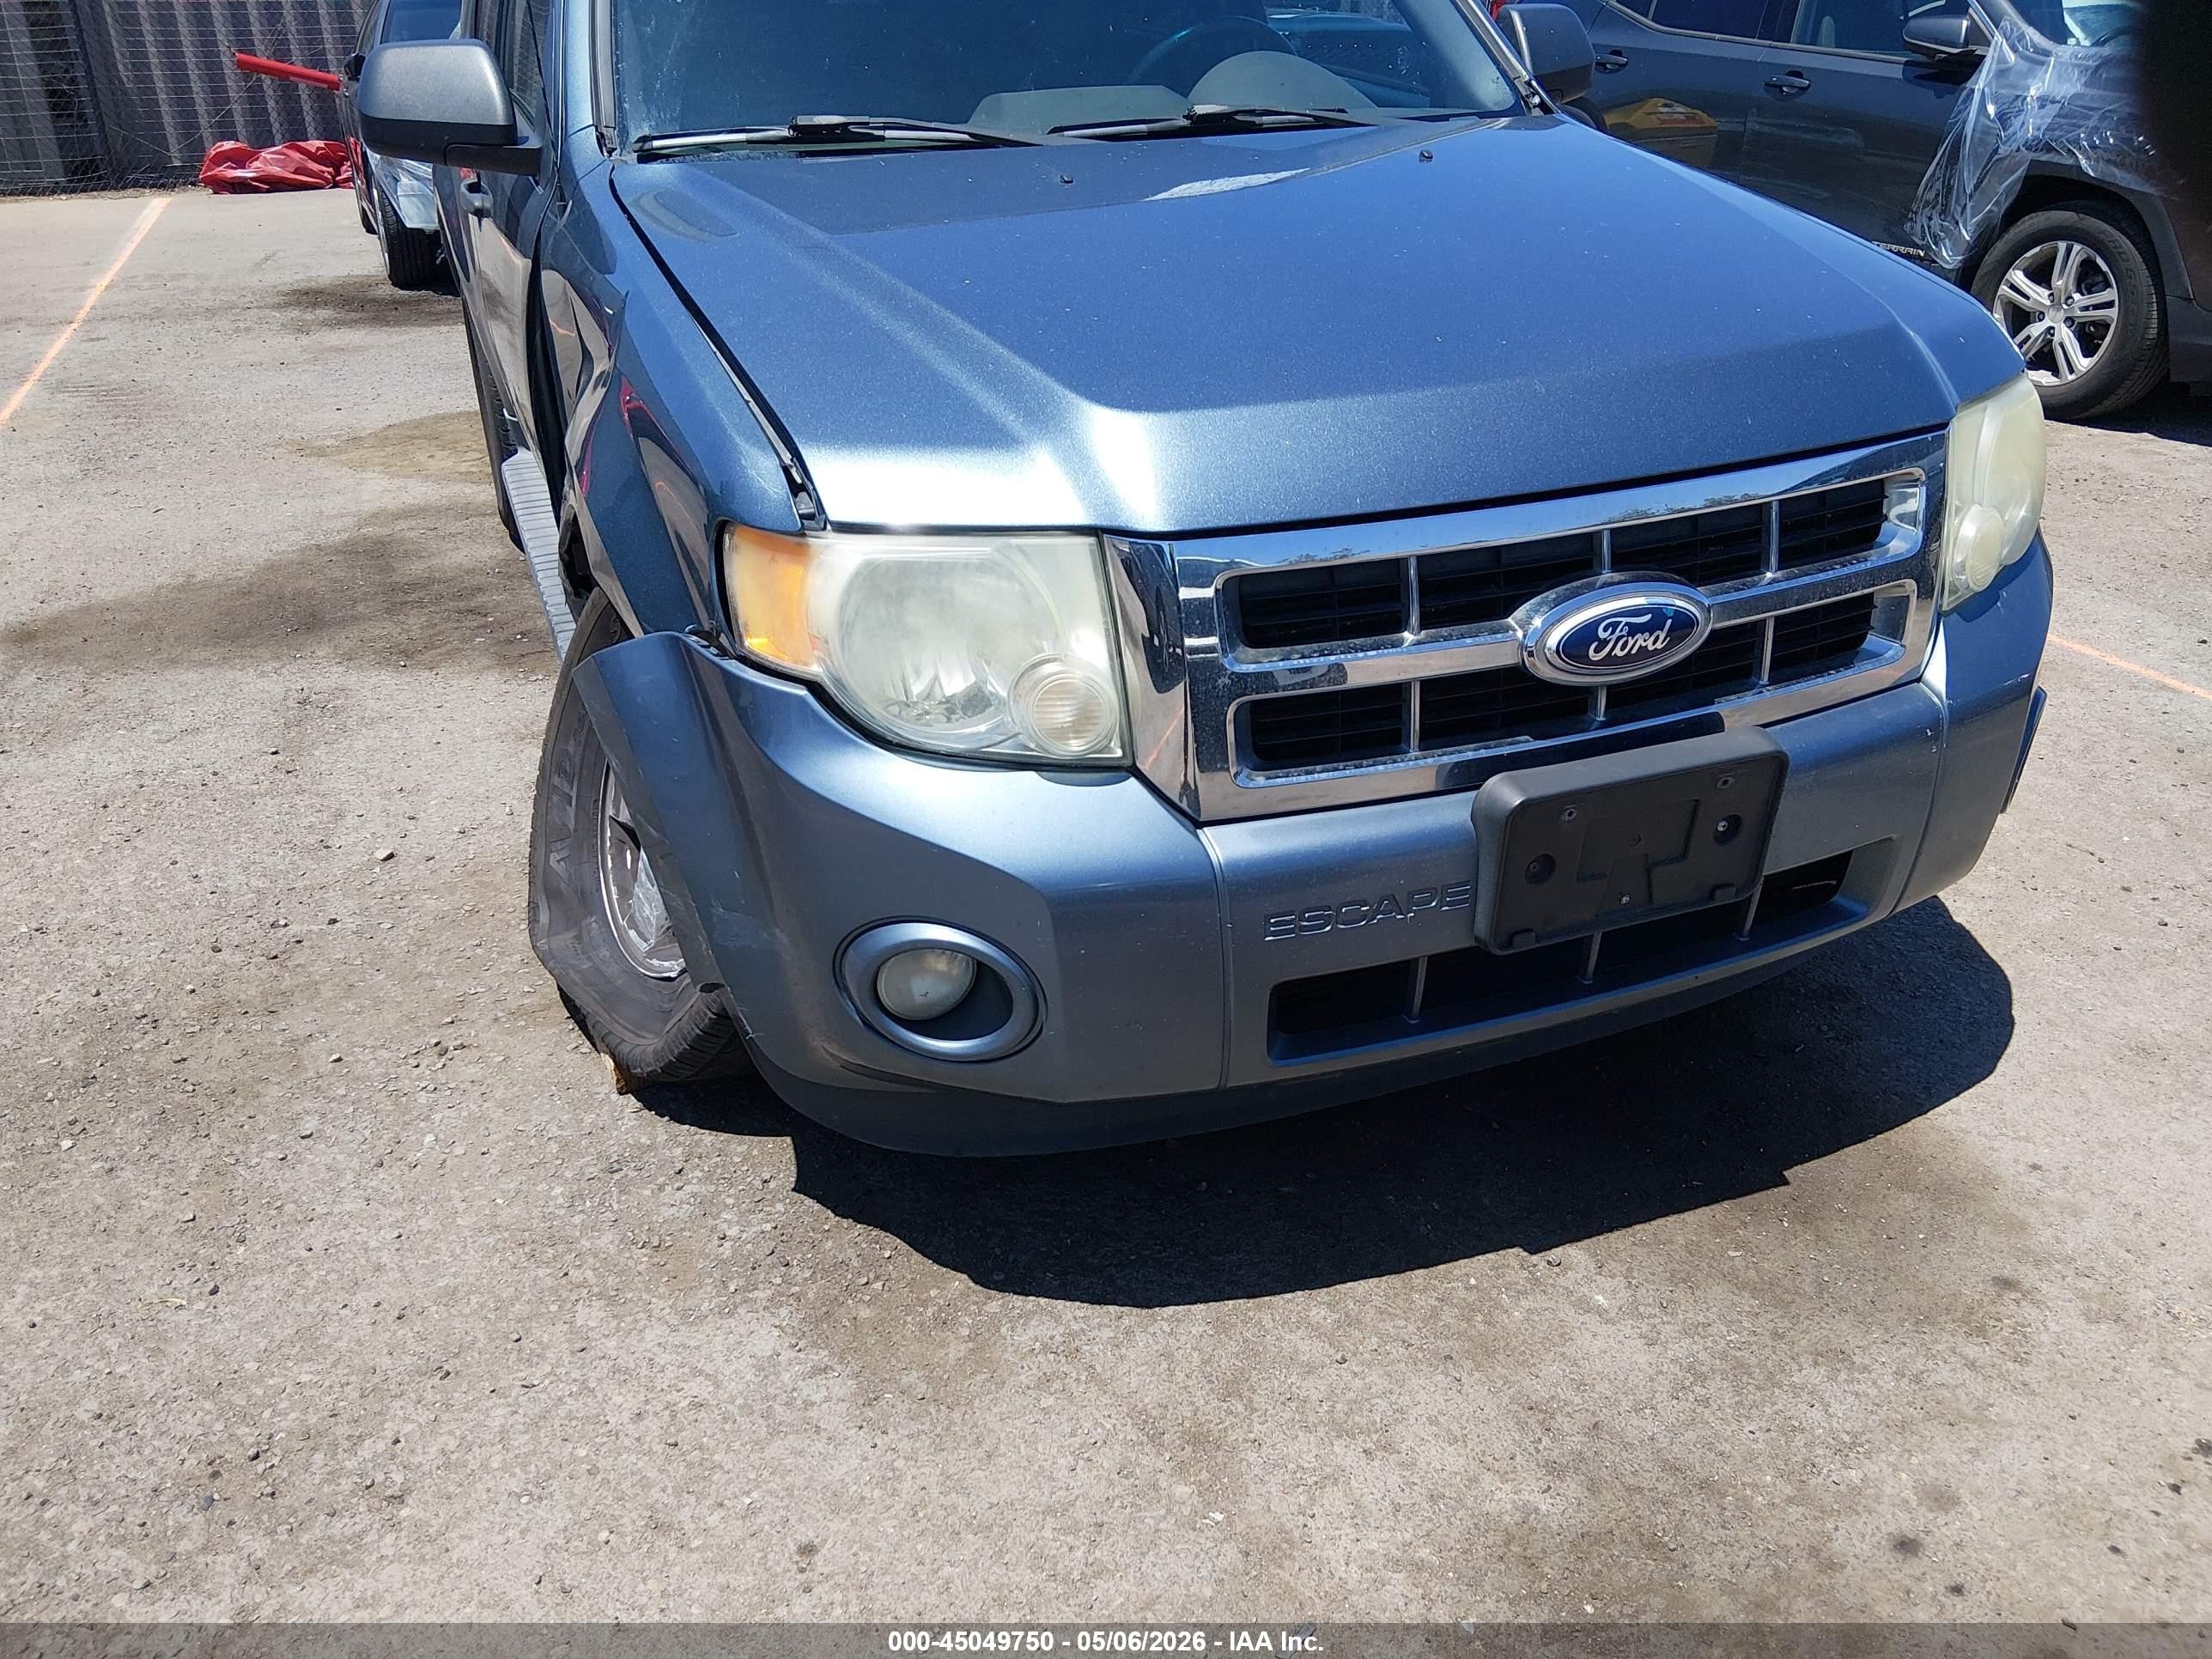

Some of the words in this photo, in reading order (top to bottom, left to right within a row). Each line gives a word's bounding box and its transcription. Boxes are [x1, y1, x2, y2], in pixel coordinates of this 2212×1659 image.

[1872, 240, 1926, 257] TERRAIN
[1589, 613, 1673, 661] Ford
[1264, 880, 1470, 941] ESCAPE
